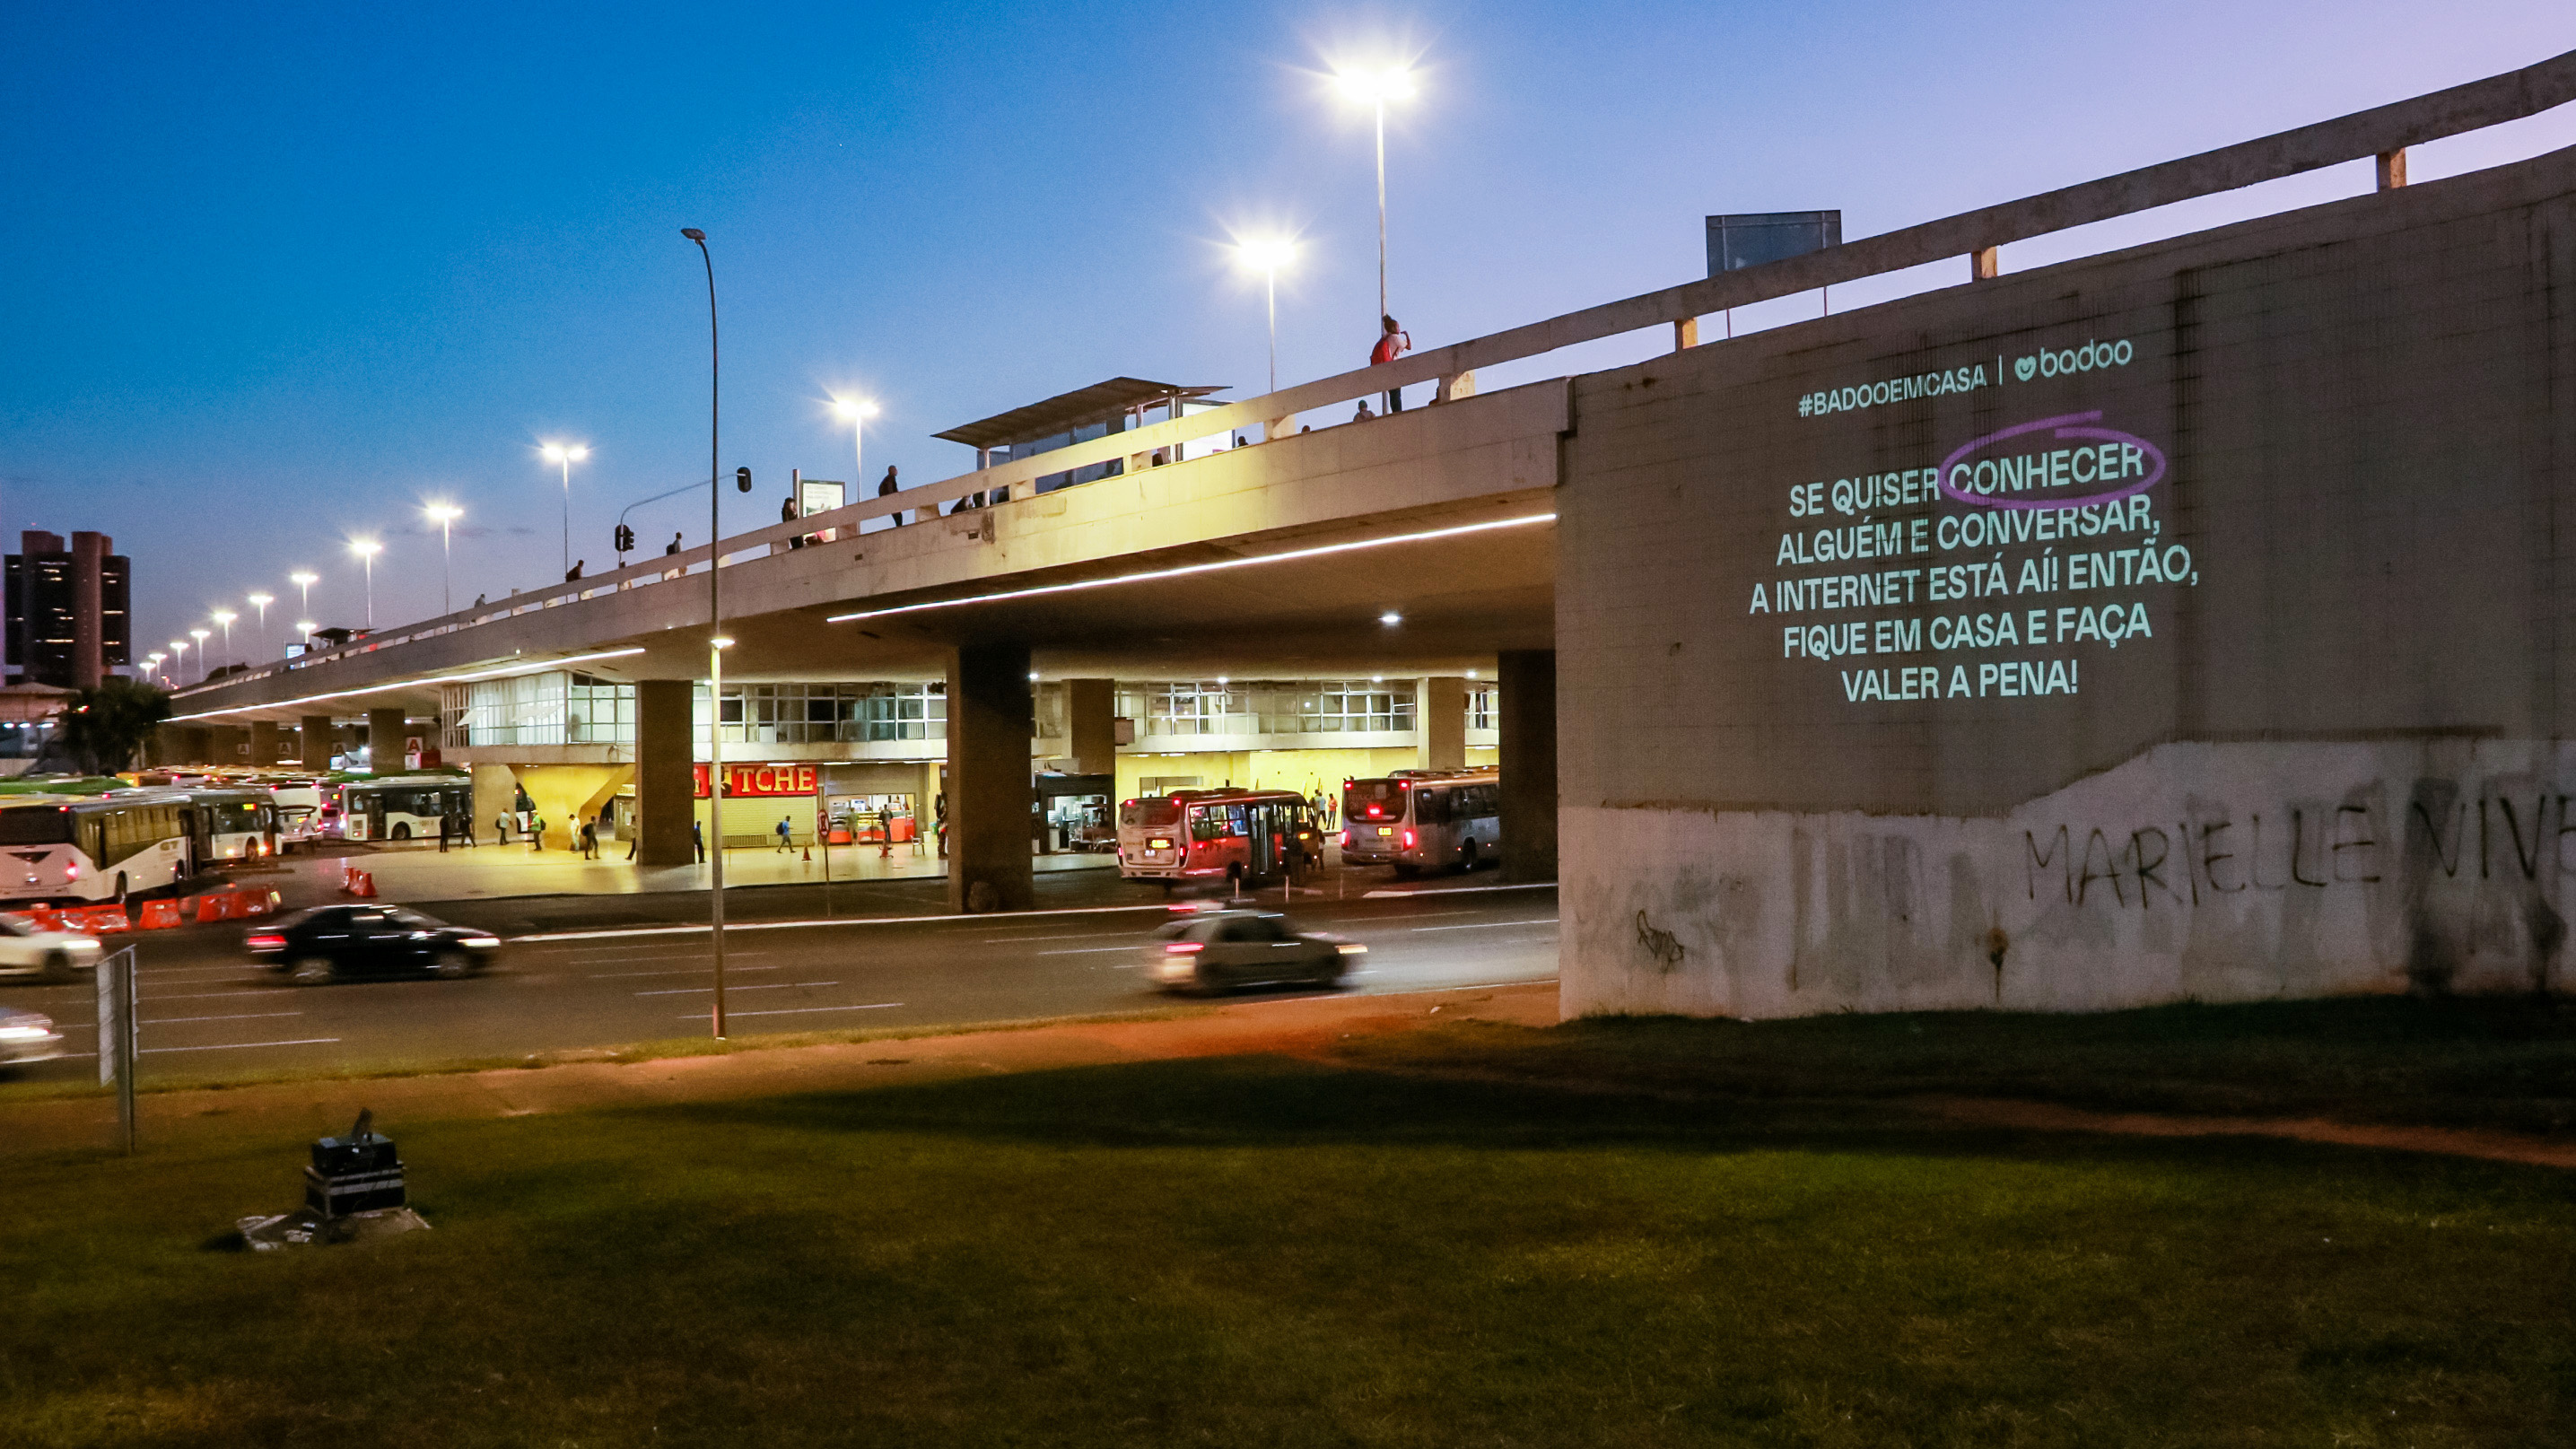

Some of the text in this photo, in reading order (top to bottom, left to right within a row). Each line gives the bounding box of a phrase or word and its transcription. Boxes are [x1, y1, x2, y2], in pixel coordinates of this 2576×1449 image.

[1798, 338, 2133, 418] #BADOOEMCASA badoo
[1789, 441, 2144, 518] SE QUISER CONHECER
[1777, 494, 2161, 566] ALGUÉM E CONVERSAR,
[1750, 537, 2198, 615] A INTERNET ESTÁ AÍ! ENTÃO,
[1785, 602, 2153, 661] FIQUE EM CASA E FAÇA
[1841, 659, 2078, 703] VALER A PENA!
[736, 767, 814, 793] TCHE
[2026, 805, 2382, 910] MARIELLE
